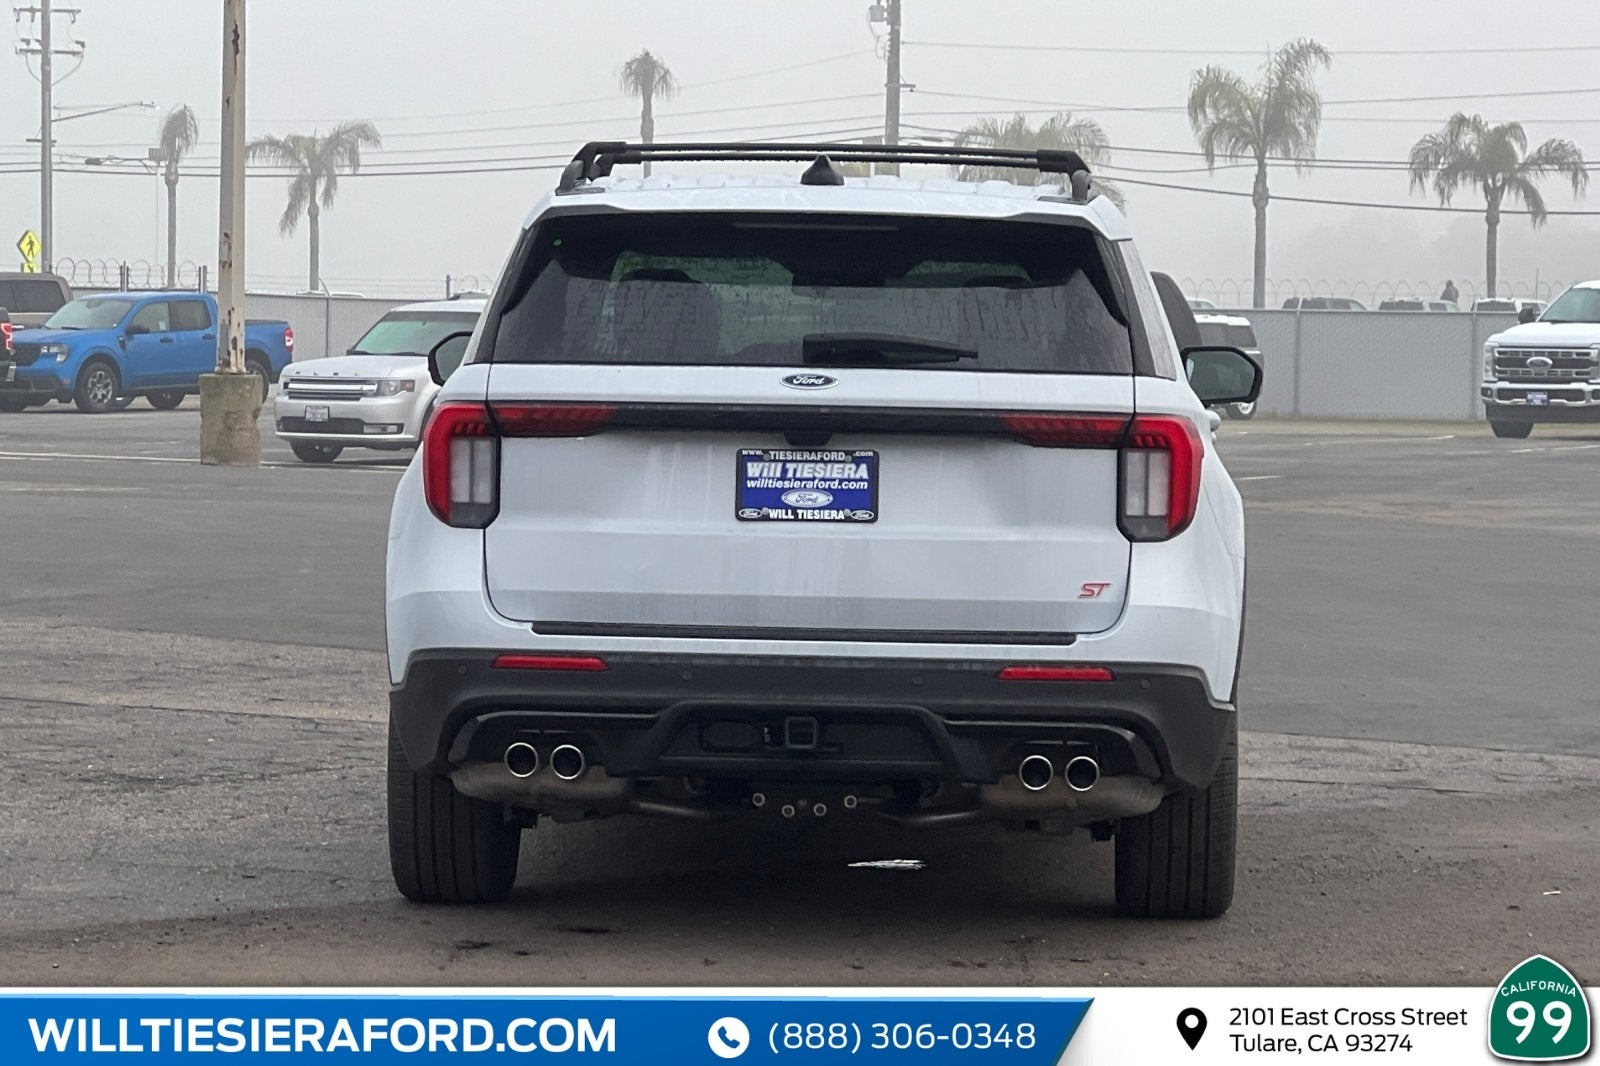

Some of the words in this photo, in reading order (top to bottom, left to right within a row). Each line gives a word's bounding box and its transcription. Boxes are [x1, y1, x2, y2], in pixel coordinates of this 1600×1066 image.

[792, 375, 825, 385] Ford
[769, 451, 846, 461] TIESIERAFORD
[746, 462, 784, 478] Will
[785, 463, 869, 479] TIESIERA
[746, 478, 868, 490] willtiesieraford.com
[795, 493, 819, 503] Ford
[769, 509, 795, 519] WILL
[796, 509, 845, 520] TIESIERA
[1078, 583, 1111, 598] ST
